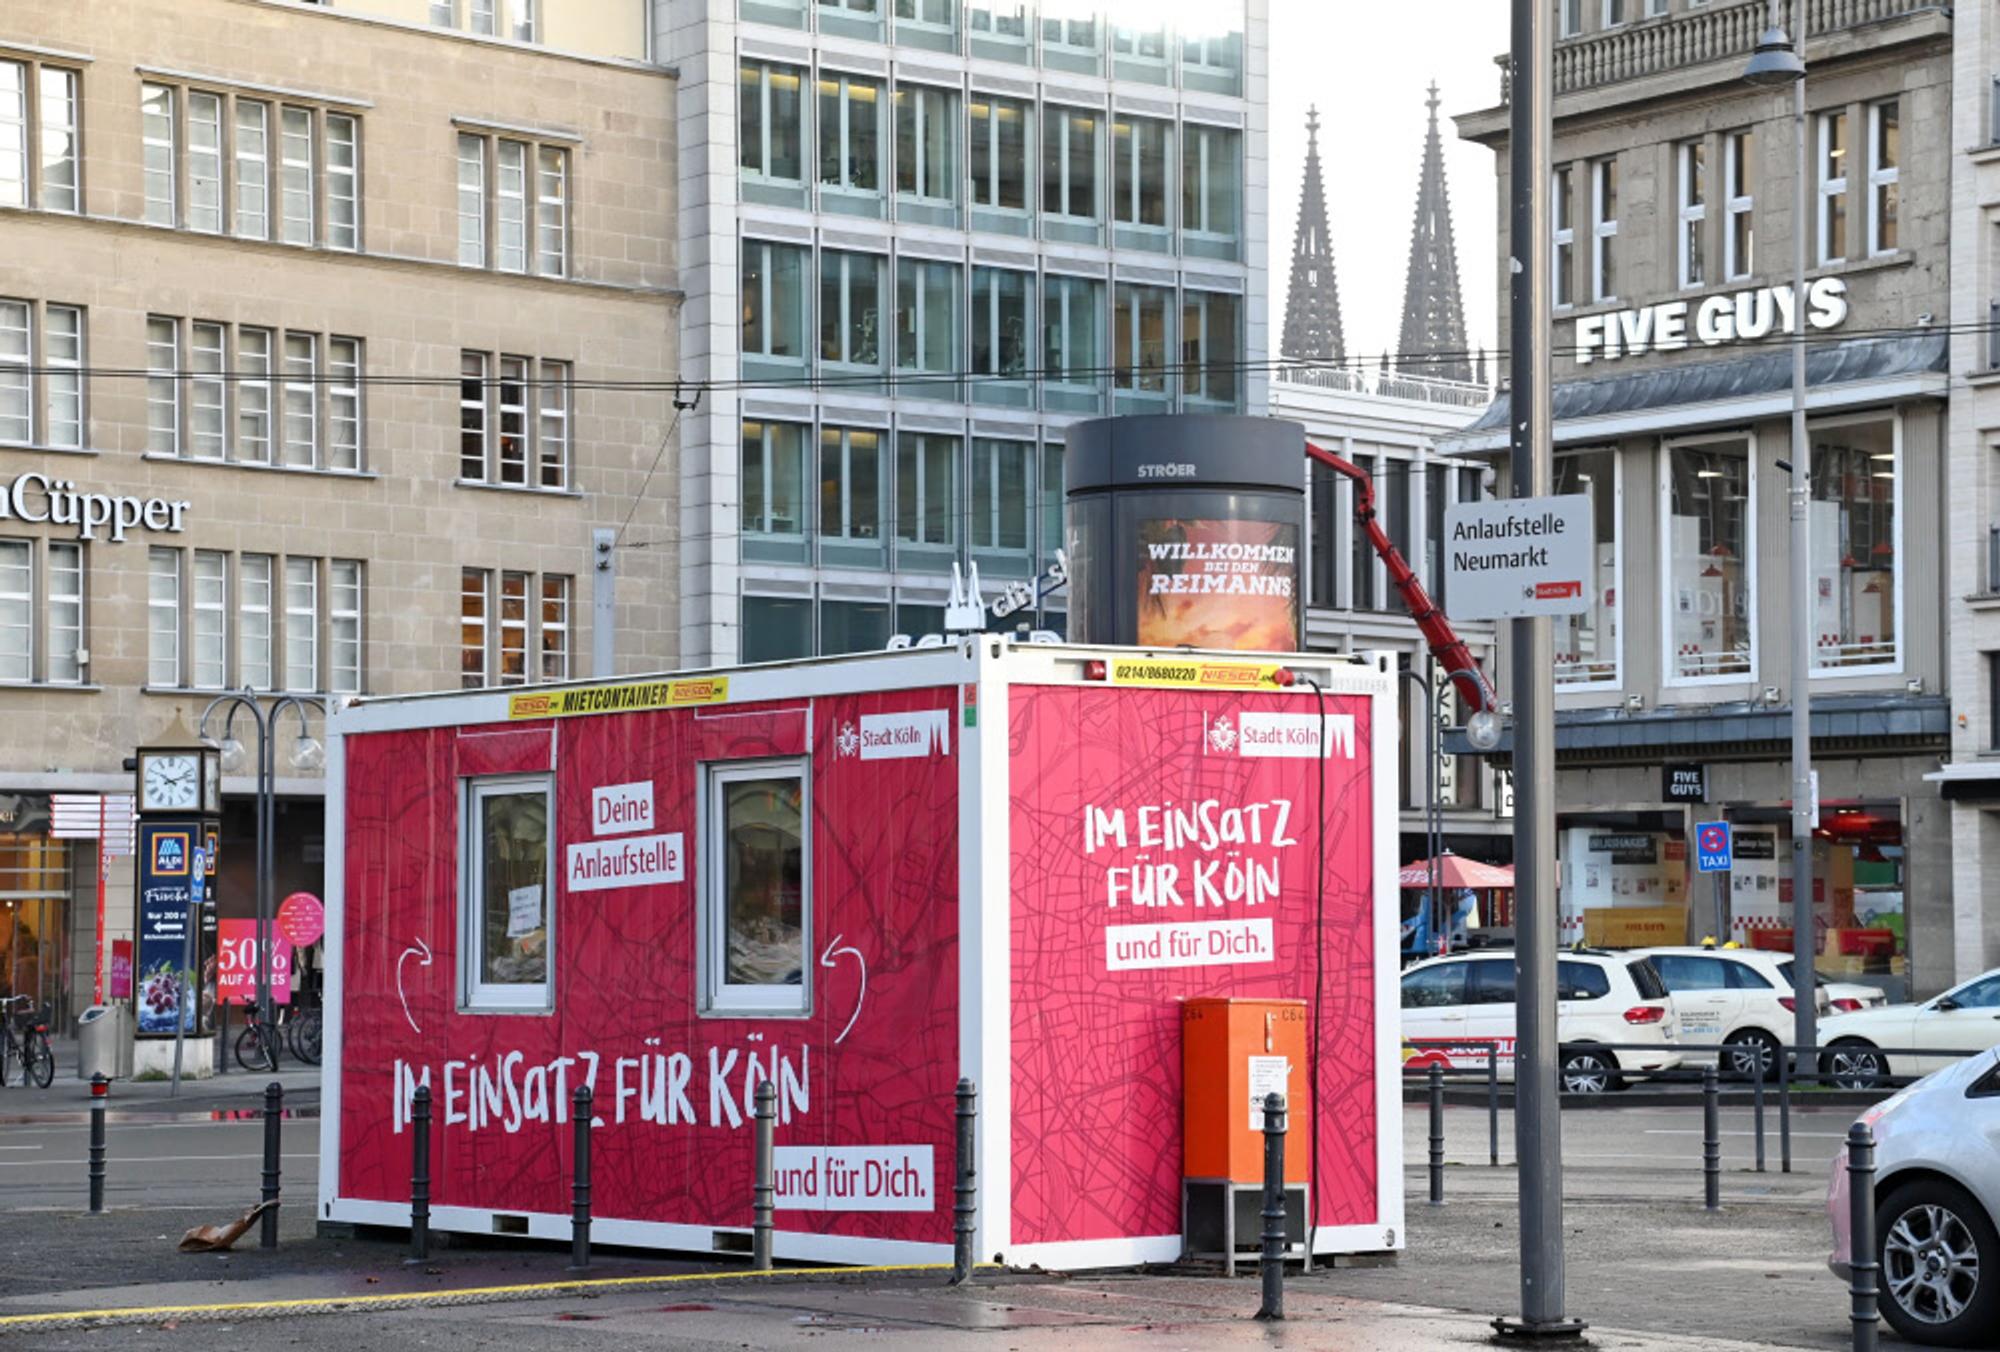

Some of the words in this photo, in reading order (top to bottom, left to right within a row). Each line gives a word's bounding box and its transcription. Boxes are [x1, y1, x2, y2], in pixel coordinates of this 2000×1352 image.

[1576, 301, 1688, 364] FIVE
[1696, 277, 1848, 345] GUYS
[1138, 463, 1196, 478] STRÖER
[1453, 512, 1565, 541] Anlaufstelle
[1148, 543, 1295, 563] WILLKOMMEN
[1454, 546, 1548, 571] Neumarkt
[1204, 562, 1229, 572] BEI
[1231, 562, 1260, 573] DEN
[1149, 574, 1292, 597] REIMANNS
[562, 684, 669, 712] MIETCONTAINER
[863, 728, 893, 746] Stadt
[894, 726, 921, 744] Köln
[1244, 727, 1282, 744] Stadt
[1286, 727, 1319, 745] Köln
[1673, 771, 1699, 783] FIVE
[1670, 784, 1702, 795] GUYS
[598, 794, 648, 824] Deine
[1085, 804, 1127, 853] IM
[158, 856, 183, 866] ALDI
[574, 841, 677, 879] Anlaufstelle
[1701, 856, 1728, 867] TAXI
[1107, 854, 1184, 908] FÜR
[1116, 931, 1162, 961] und
[1169, 930, 1201, 957] für
[1208, 926, 1266, 955] Dich.
[219, 974, 244, 985] AUF
[393, 1058, 432, 1134] IM
[615, 1038, 697, 1125] FÜR
[774, 1156, 817, 1196] und
[825, 1156, 859, 1197] für
[865, 1156, 926, 1197] Dich.
